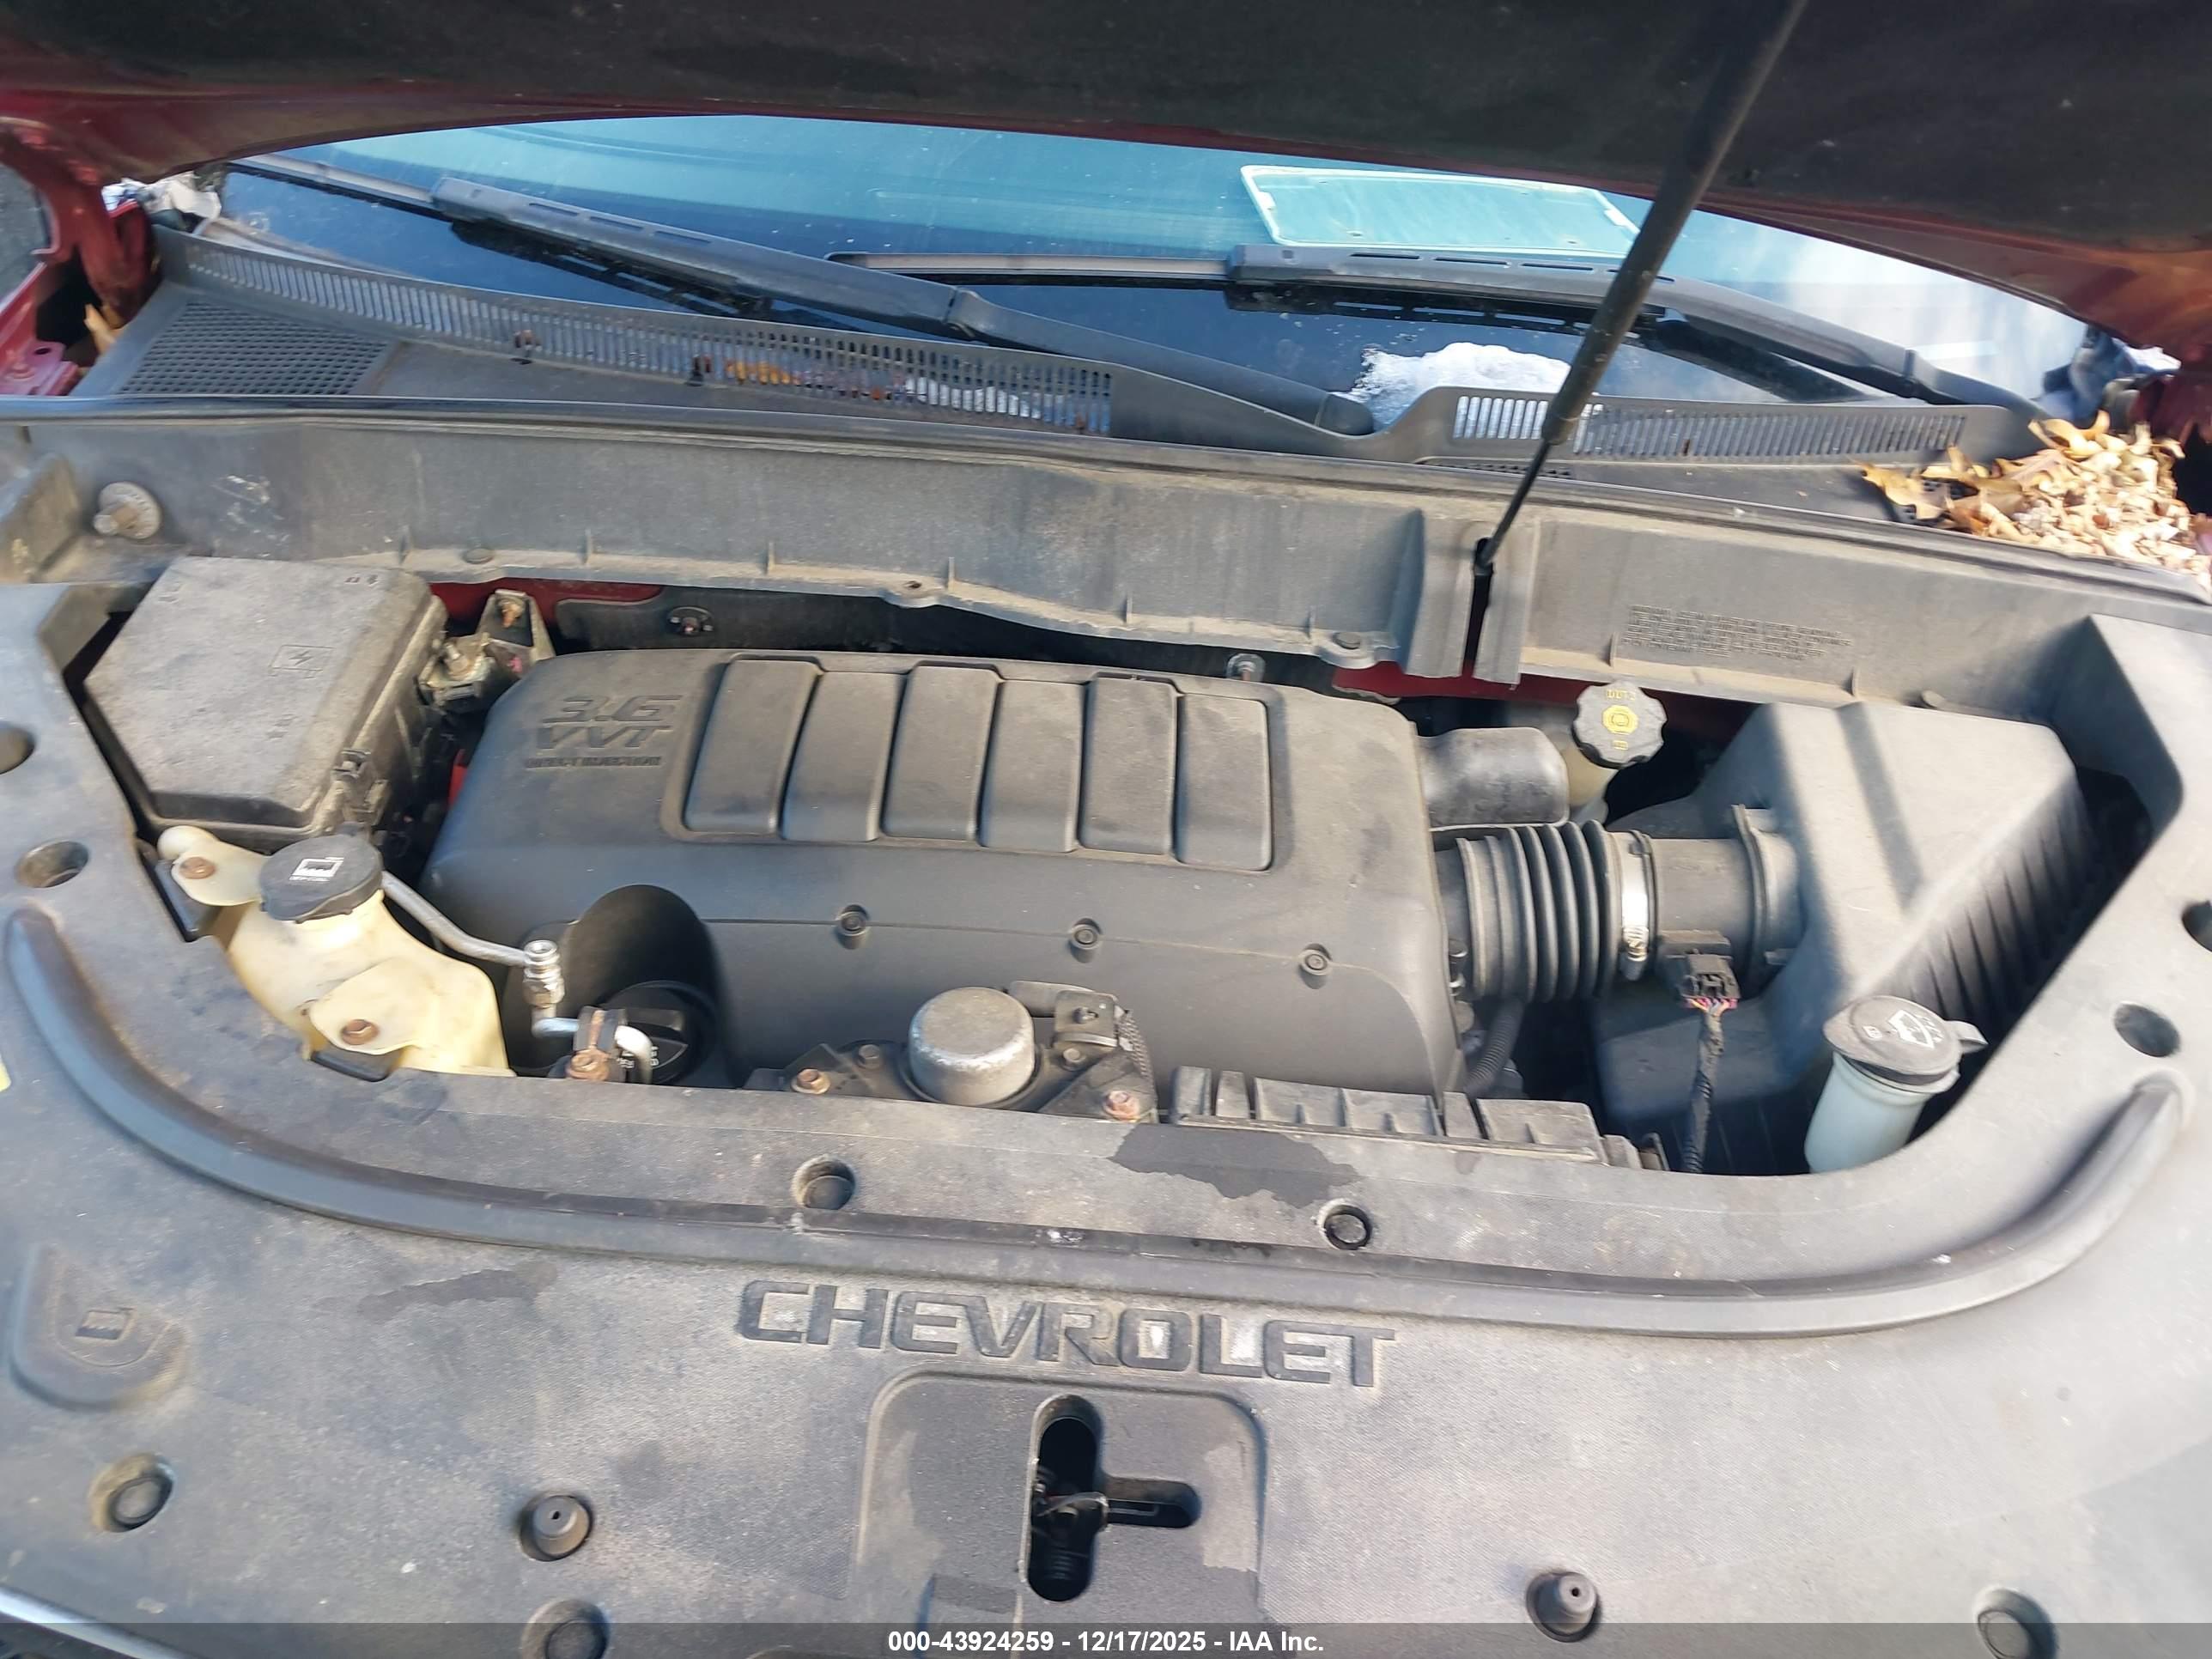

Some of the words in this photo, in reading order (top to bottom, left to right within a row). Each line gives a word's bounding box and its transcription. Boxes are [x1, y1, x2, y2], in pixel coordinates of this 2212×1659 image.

[540, 695, 684, 723] 3.6
[535, 726, 672, 750] VVT
[738, 1279, 1396, 1388] CHEVROLET
